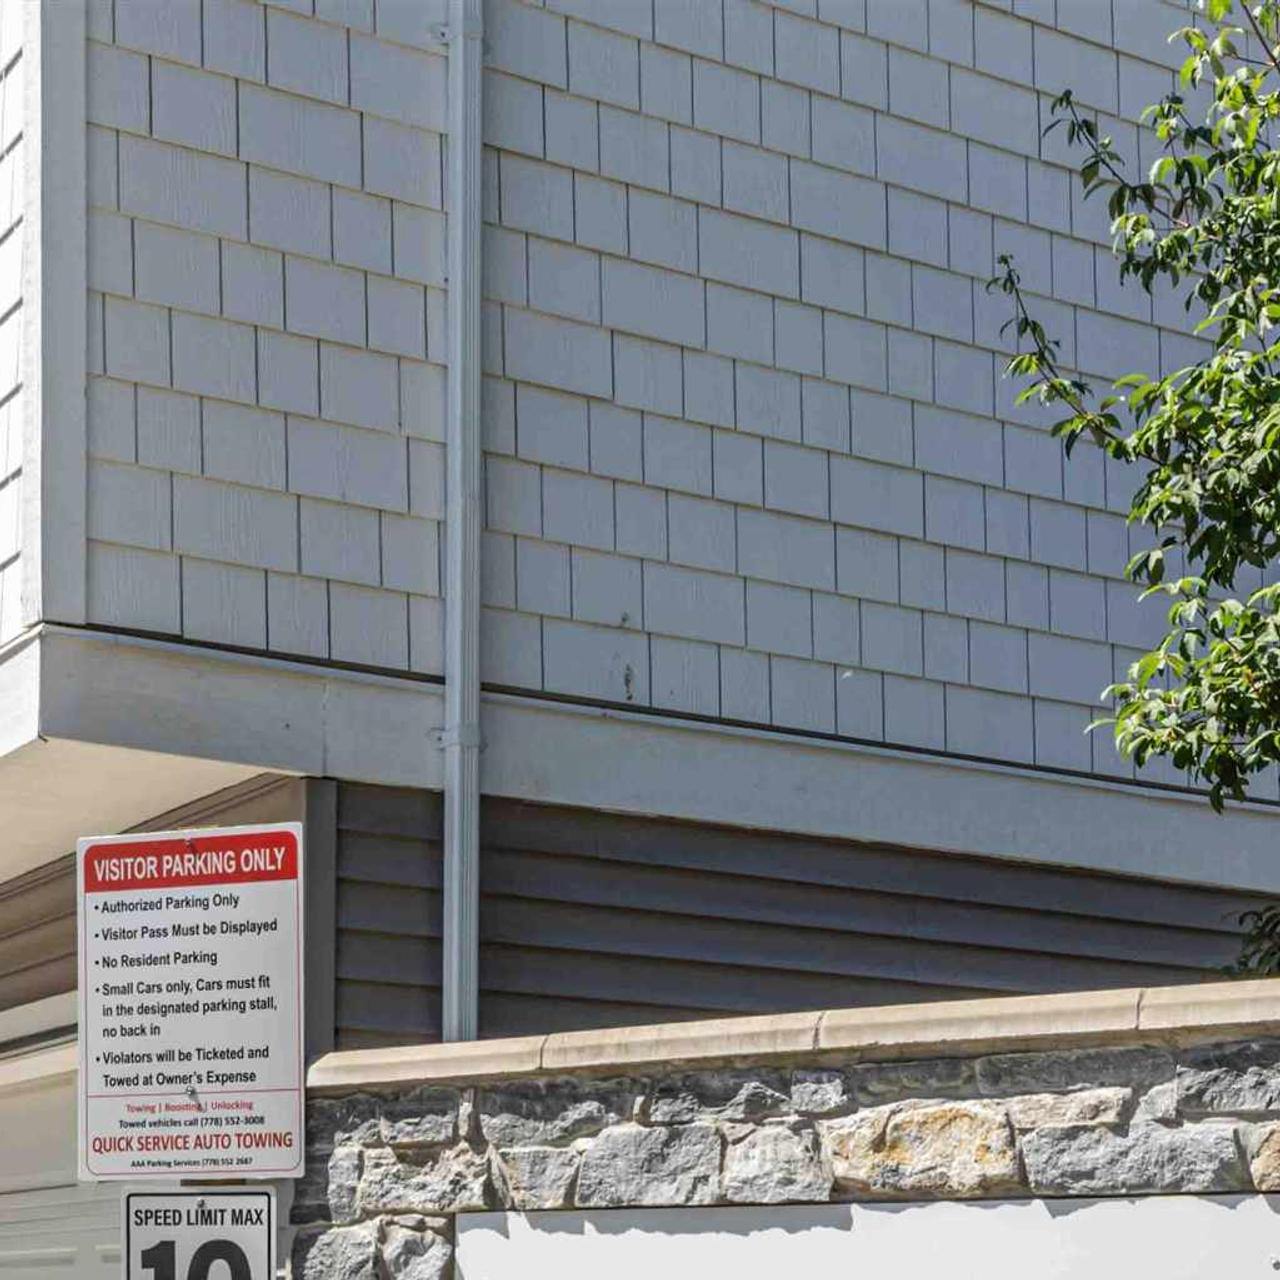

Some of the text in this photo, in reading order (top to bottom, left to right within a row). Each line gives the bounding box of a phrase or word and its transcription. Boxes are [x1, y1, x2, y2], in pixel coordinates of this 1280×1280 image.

[94, 847, 285, 882] VISITOR PARKING ONLY
[101, 893, 239, 914] Authorized Parking Only
[102, 918, 277, 941] Visitor Pass Must be Displayed
[102, 951, 217, 968] No Resident Parking
[102, 975, 270, 996] Small Cars only, Cars must fit
[102, 997, 277, 1017] in the designated parking stall,
[103, 1024, 160, 1038] no back in
[103, 1046, 269, 1065] Violators will be Ticketed and
[104, 1071, 256, 1087] Towed at Owner's Expense
[126, 1103, 155, 1113] Towing
[211, 1101, 253, 1110] Unlocking
[119, 1120, 146, 1129] Towed
[149, 1119, 182, 1128] vehicles
[184, 1118, 198, 1126] call
[200, 1117, 222, 1128] (778)
[93, 1131, 293, 1154] QUICK SERVICE AUTO TOWING
[147, 1160, 171, 1168] Parking
[134, 1209, 263, 1226] SPEED LIMIT MAX
